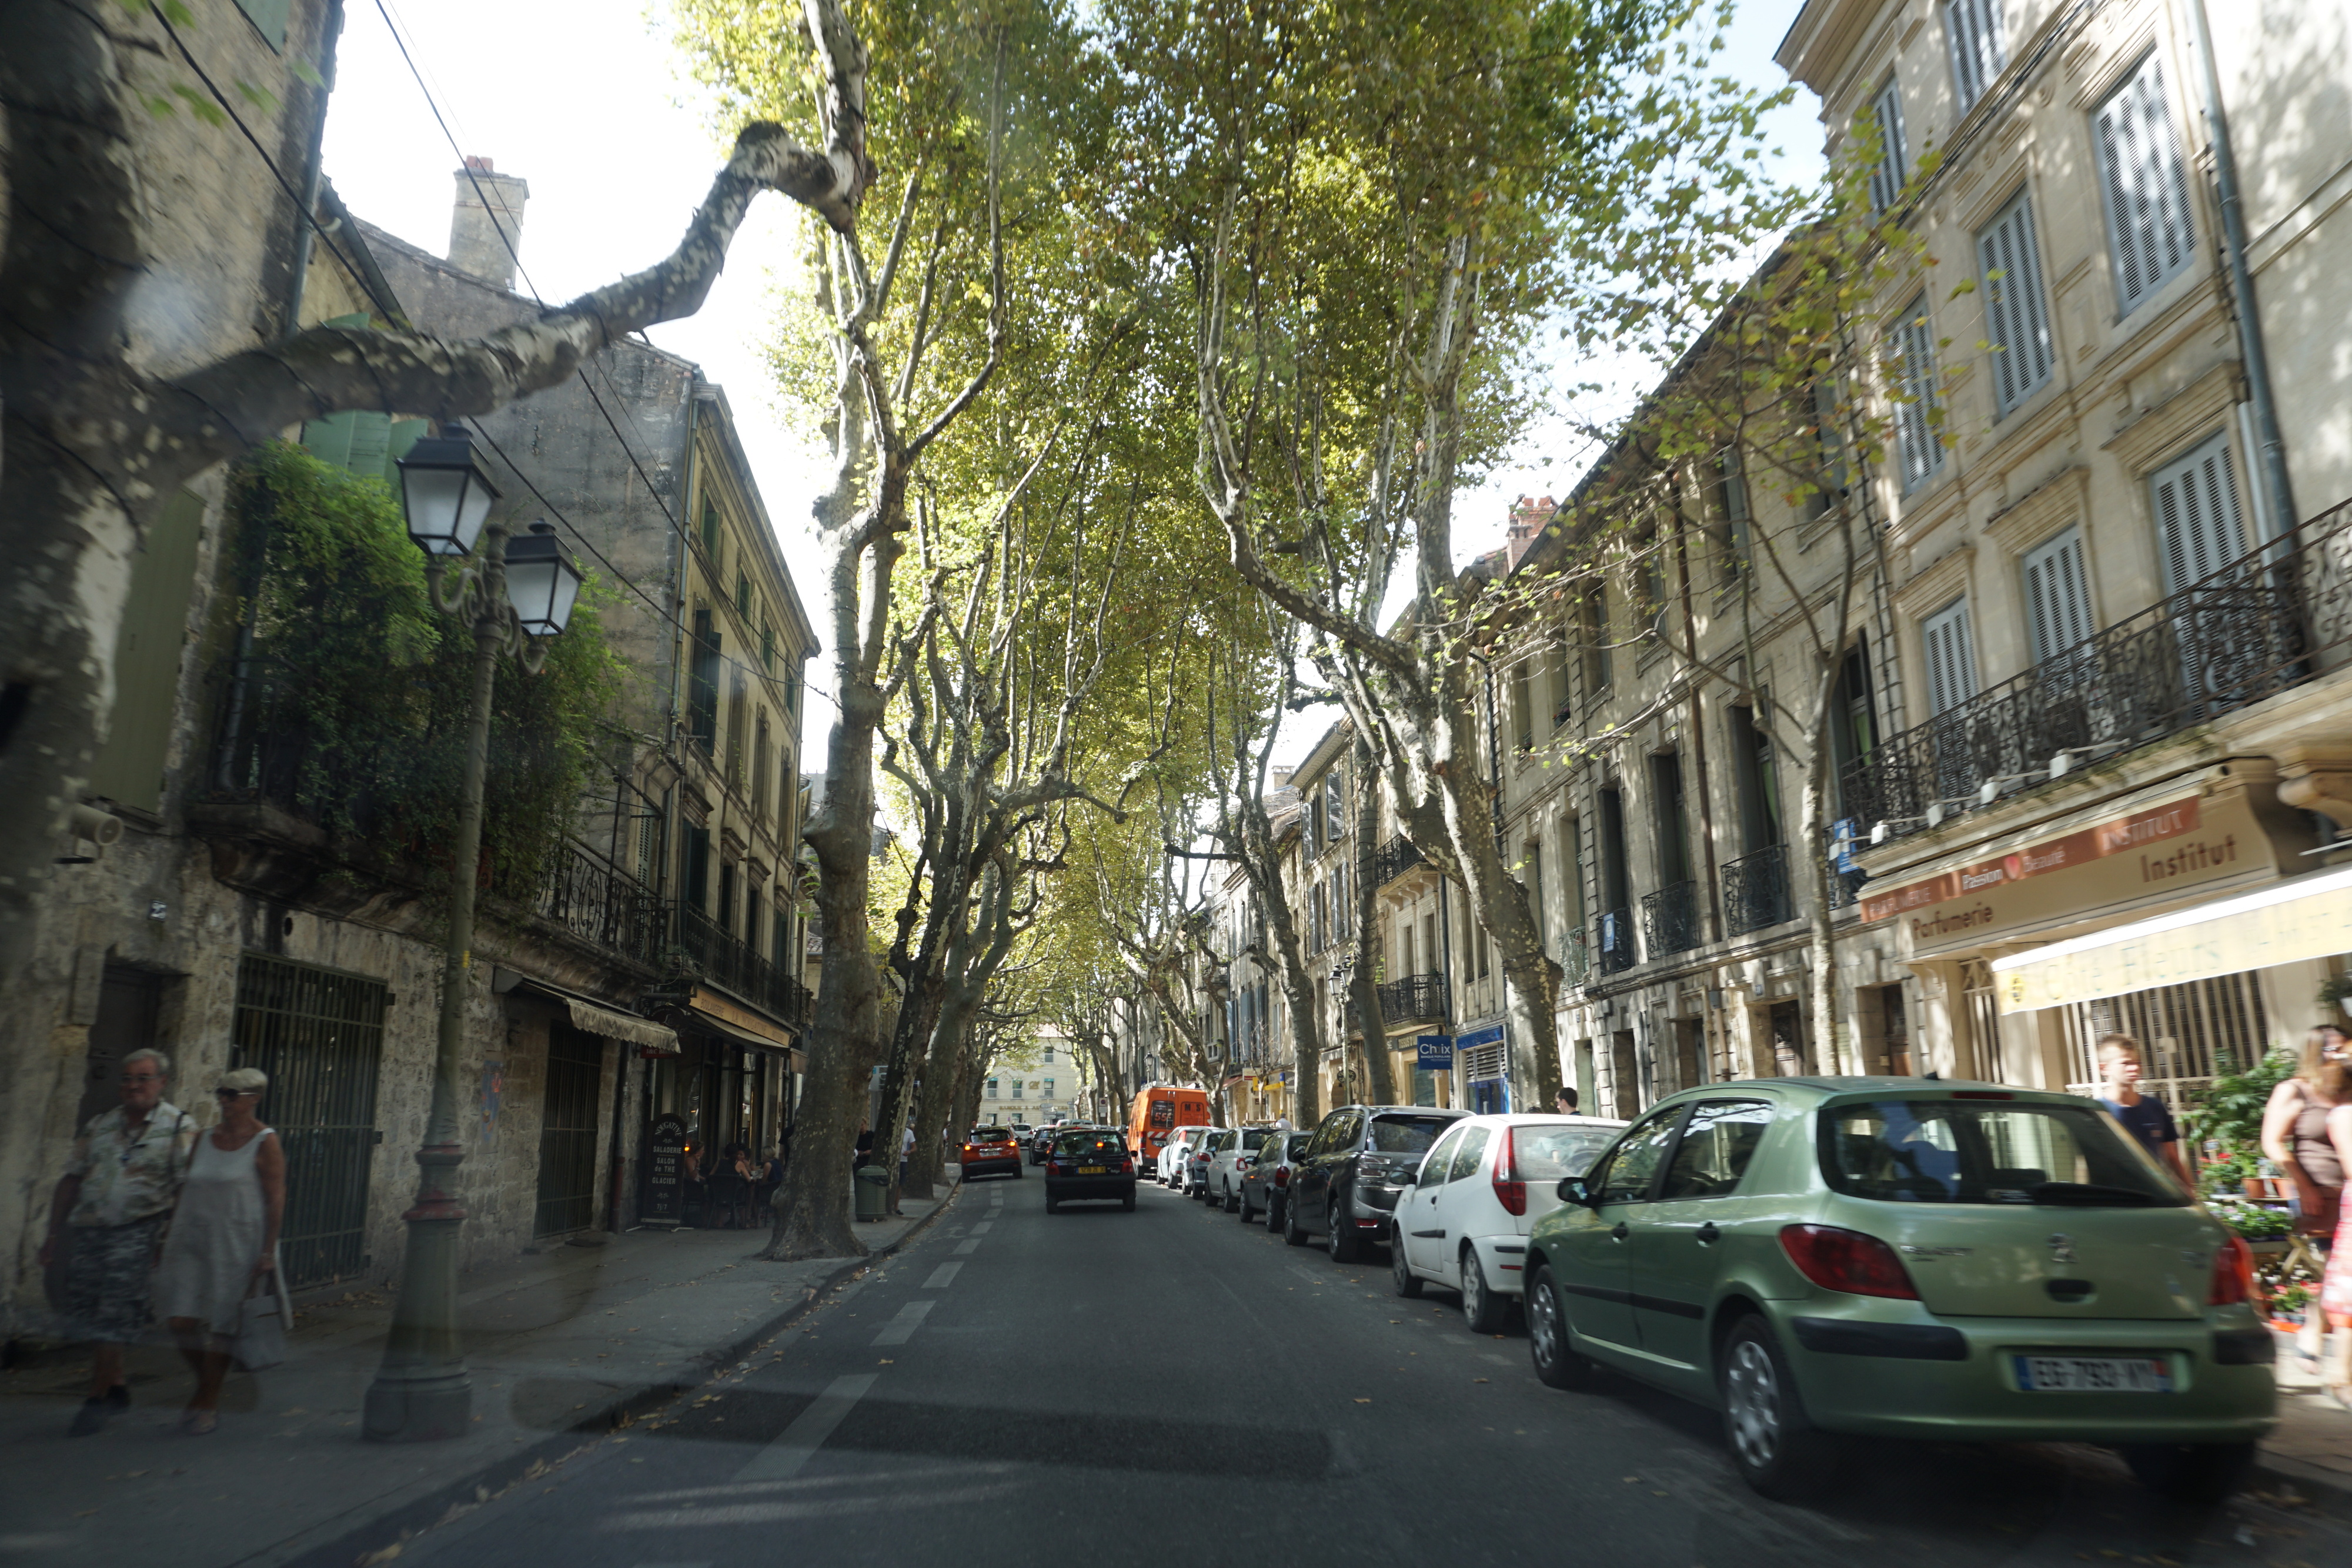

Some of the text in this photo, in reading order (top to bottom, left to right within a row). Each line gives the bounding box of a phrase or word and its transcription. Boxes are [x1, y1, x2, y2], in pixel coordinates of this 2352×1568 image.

[1869, 809, 2183, 918] PARFUMERIE Passion Beauté INSTITUT
[1912, 832, 2237, 941] Parfumerie Institut
[731, 1011, 739, 1024] LA
[654, 1121, 681, 1136] NOUGATINE
[653, 1146, 681, 1154] SALADERIE
